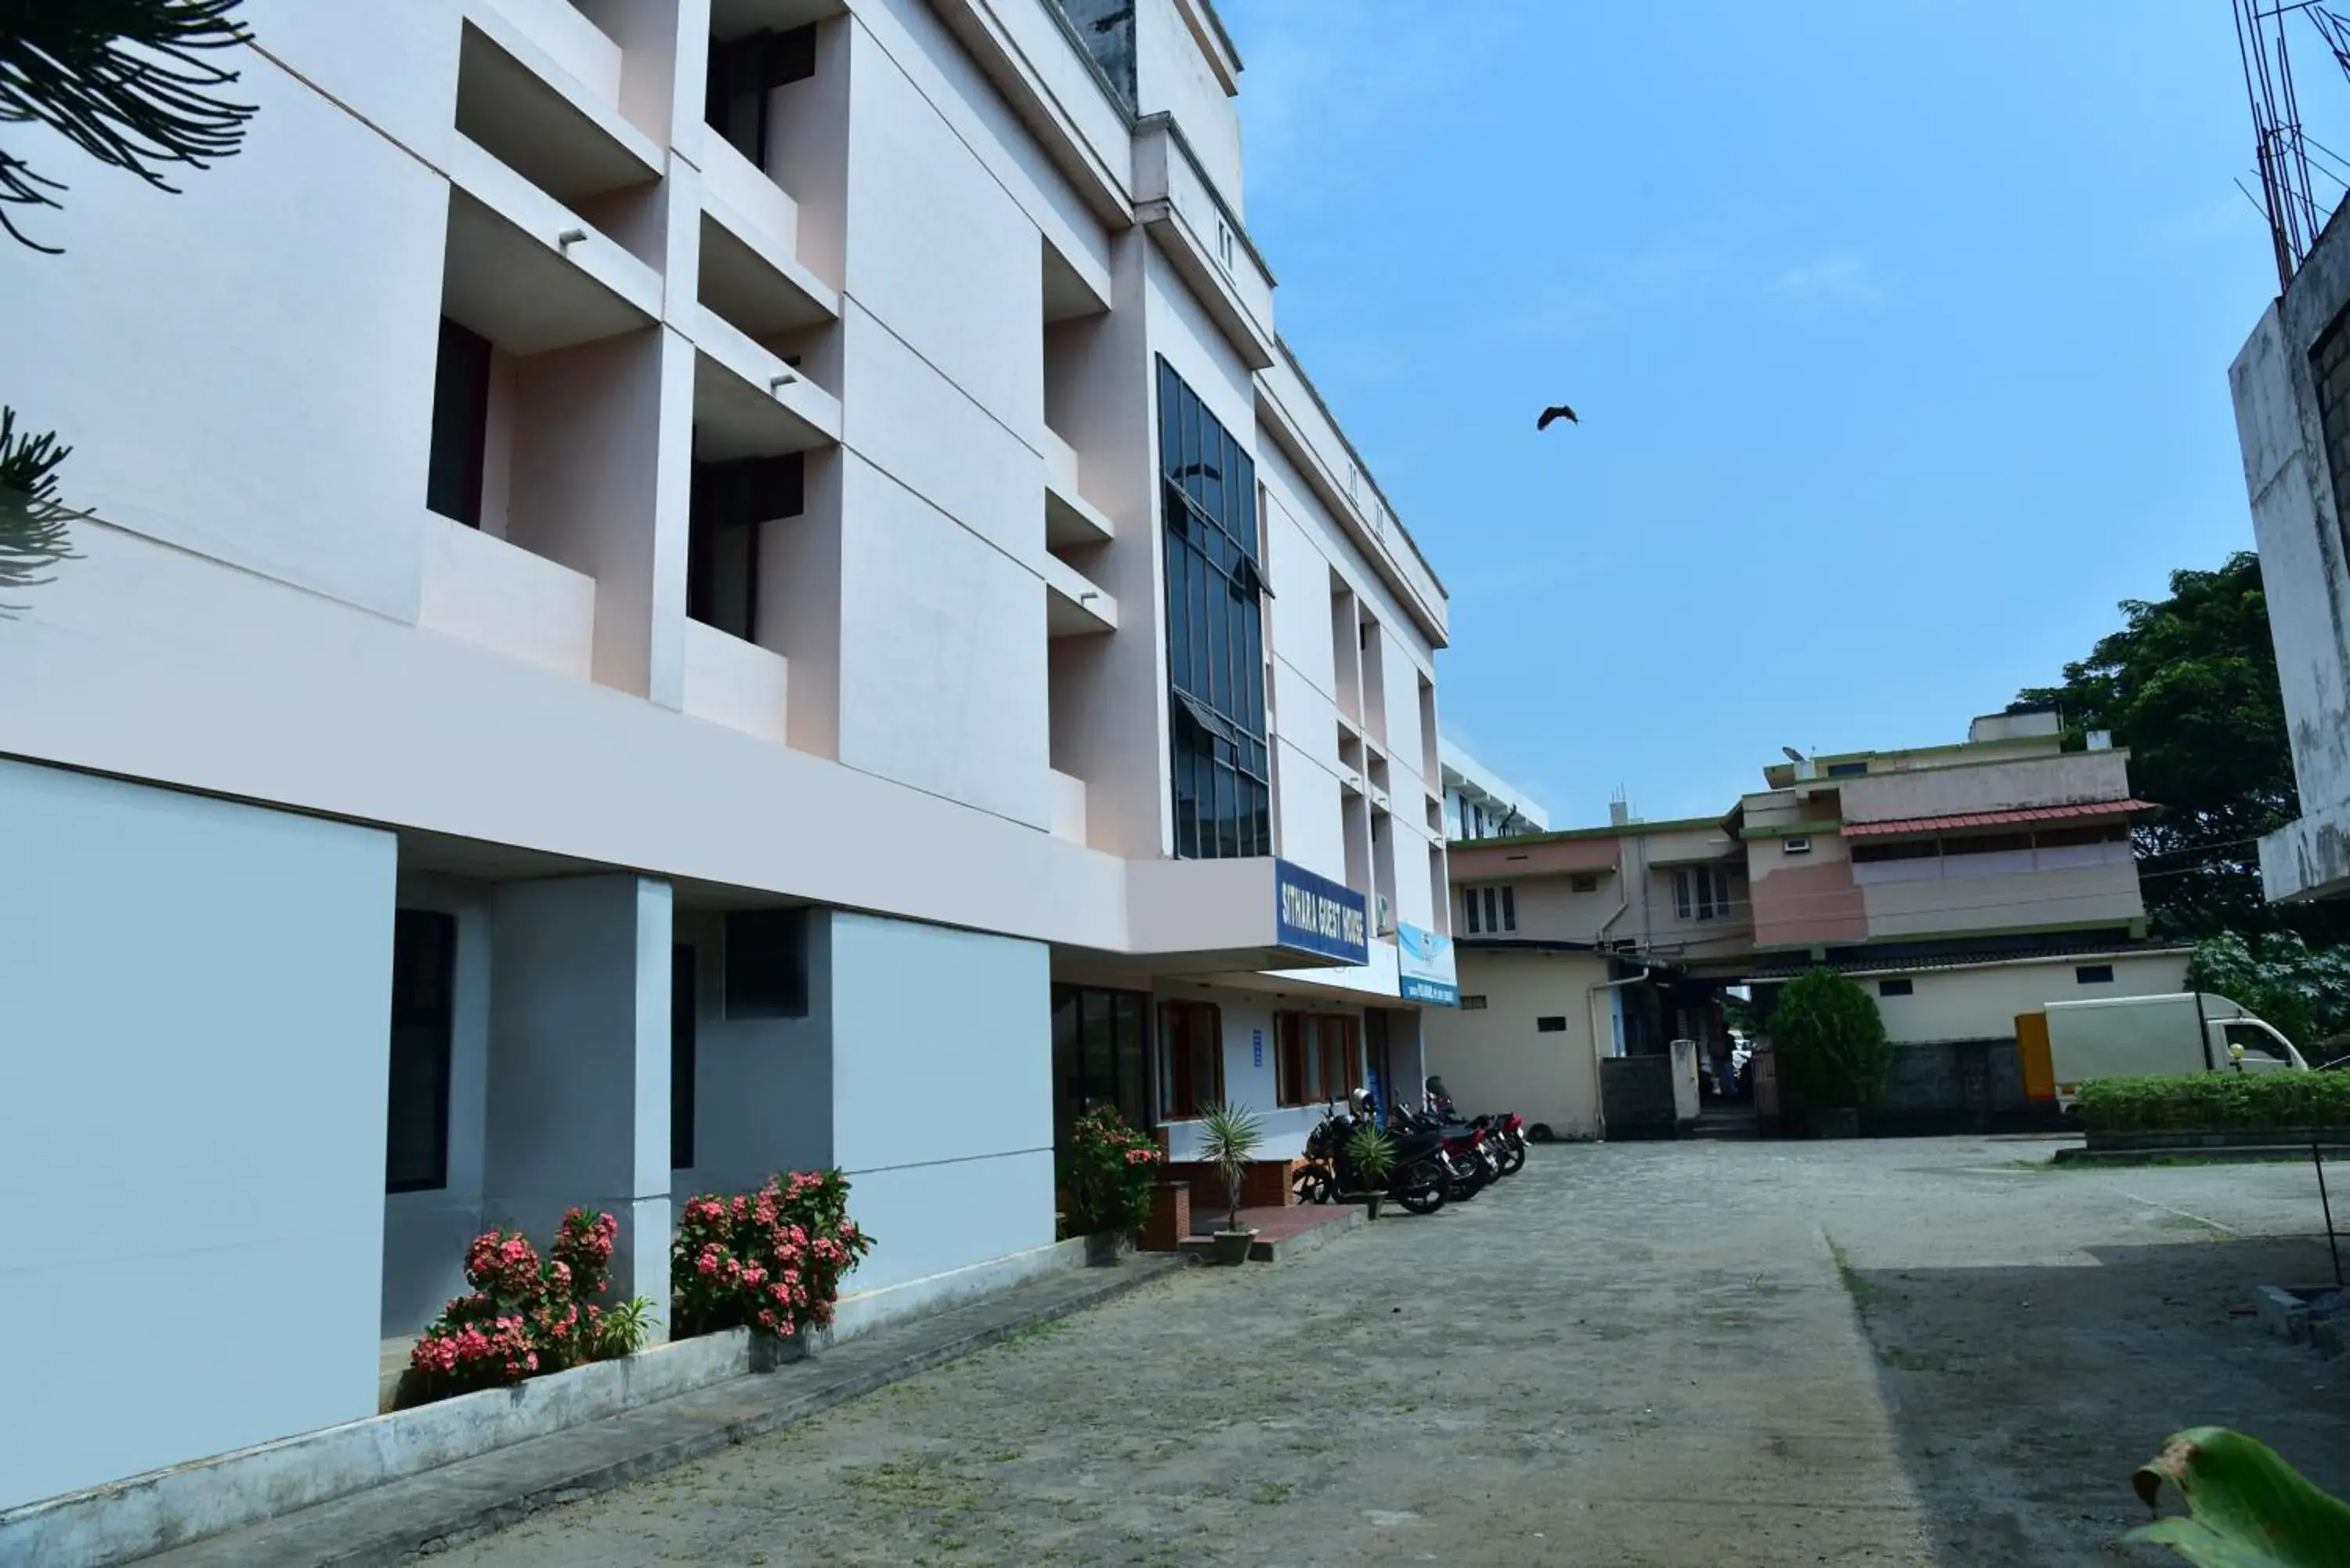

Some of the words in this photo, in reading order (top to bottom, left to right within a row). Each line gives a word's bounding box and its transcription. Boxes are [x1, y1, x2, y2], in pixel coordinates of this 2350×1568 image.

[1282, 880, 1318, 933] SITHARA
[1318, 895, 1341, 941] GUEST
[1342, 905, 1364, 947] HOUSE
